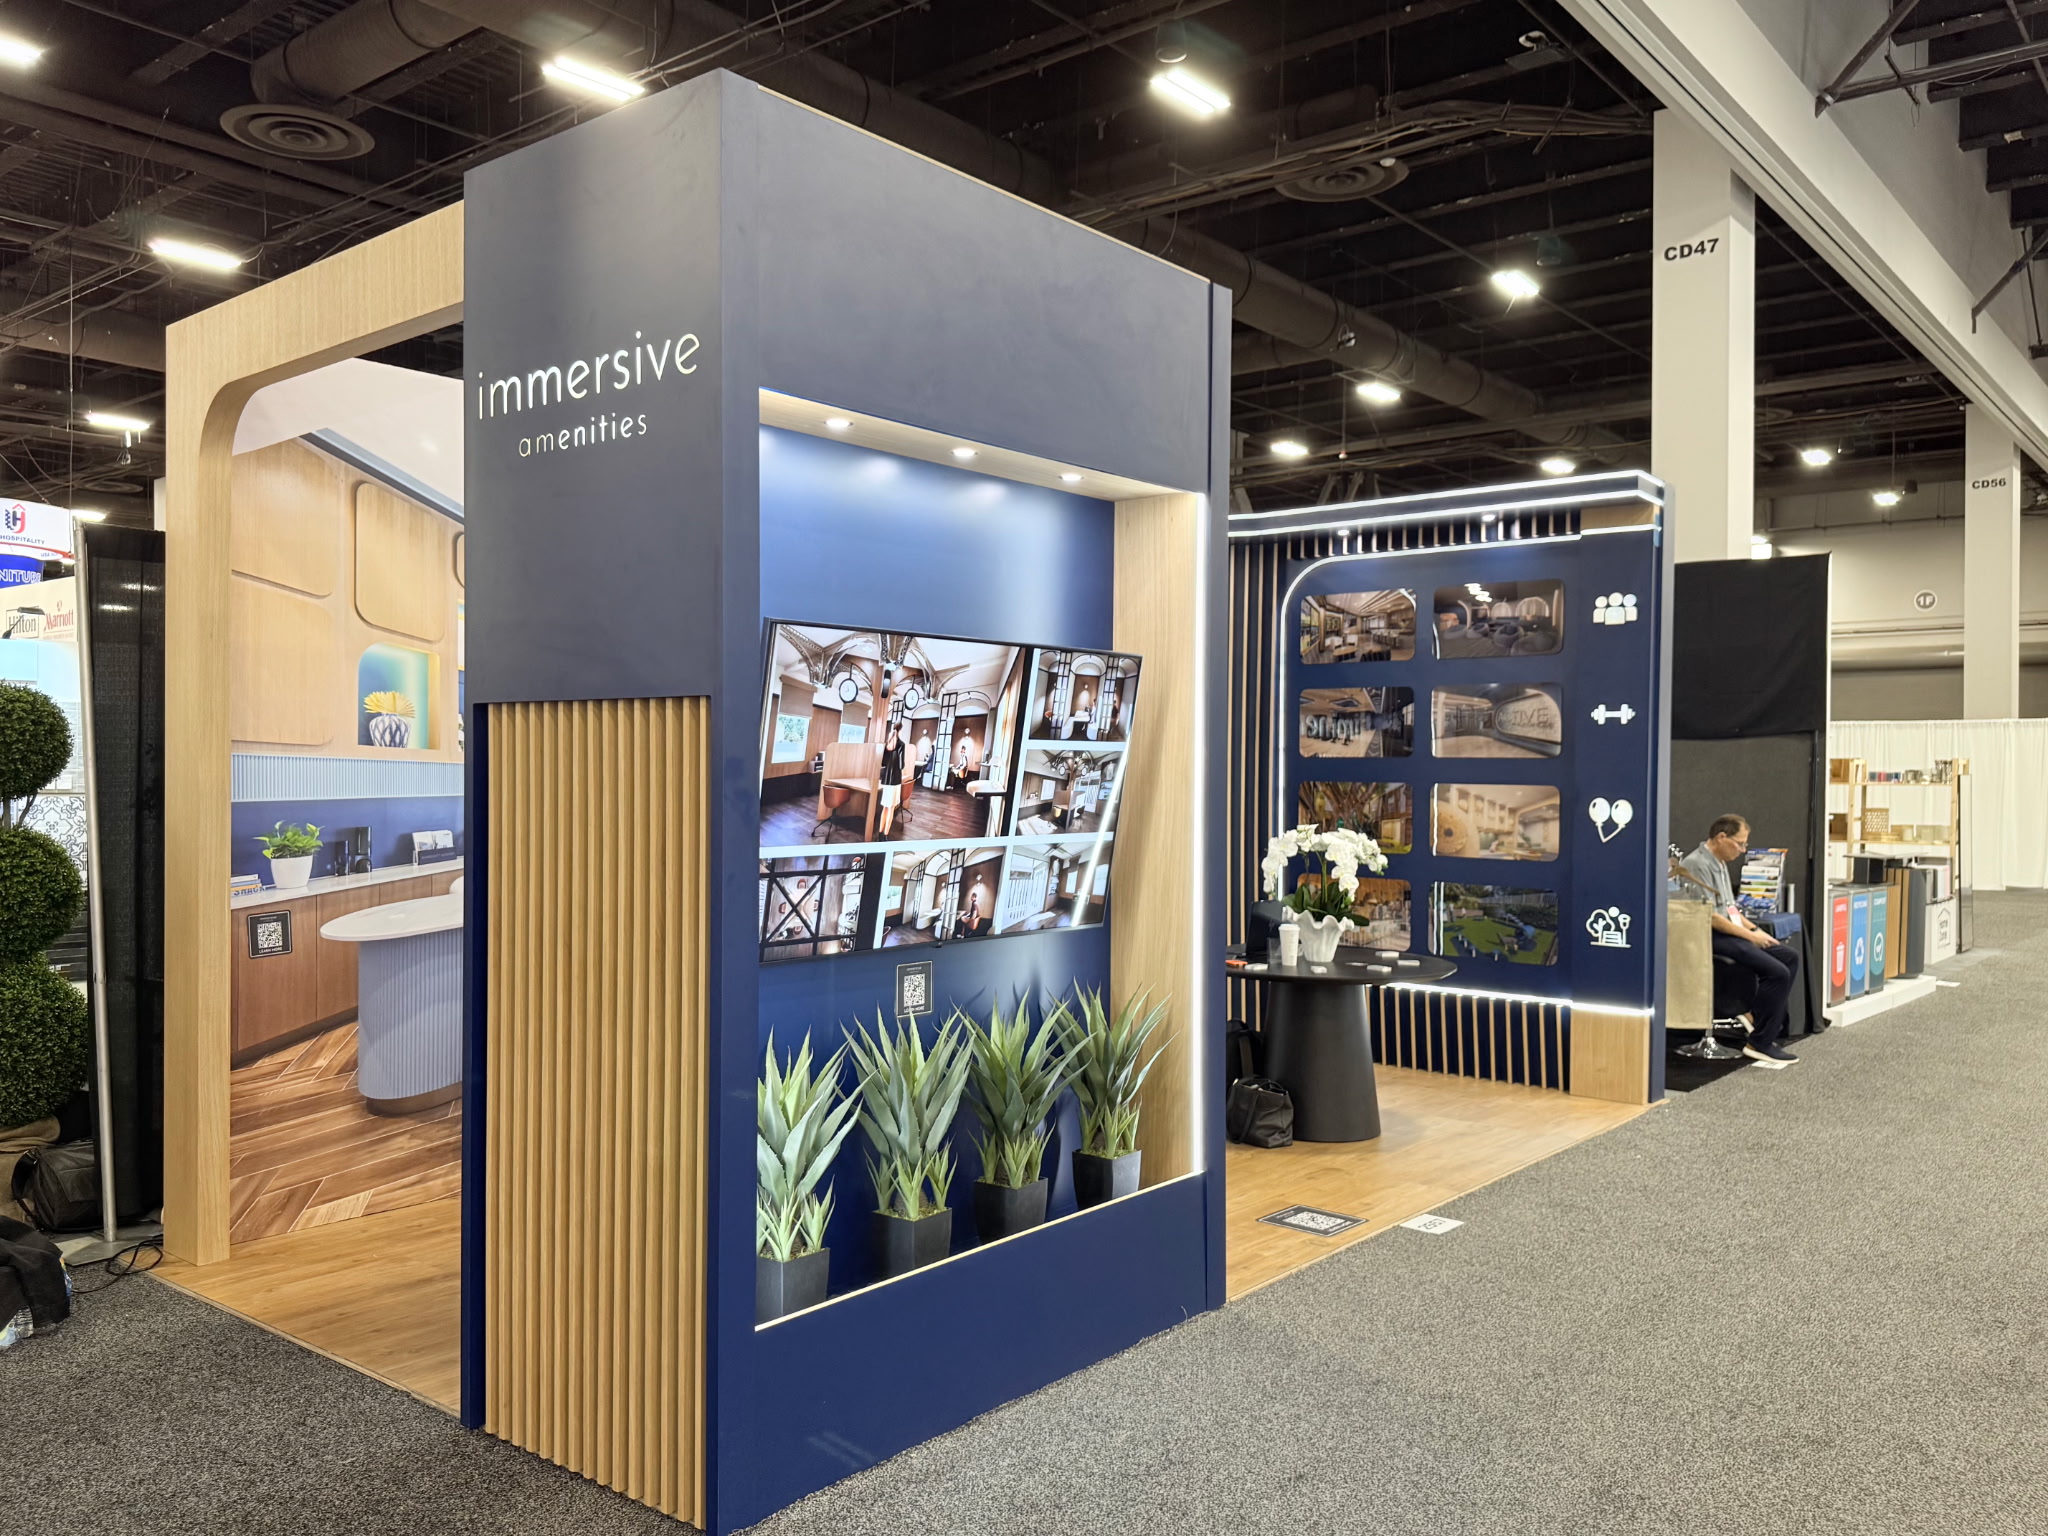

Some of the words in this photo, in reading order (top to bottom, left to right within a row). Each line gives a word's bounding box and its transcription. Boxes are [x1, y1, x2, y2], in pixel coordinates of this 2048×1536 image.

[1664, 237, 1720, 261] CD47
[478, 330, 700, 420] immersive
[518, 412, 647, 457] amenities
[1972, 477, 2007, 489] CD56
[0, 534, 45, 545] HOSPITALITY
[8, 614, 37, 634] Hilton
[43, 609, 74, 632] Marriott
